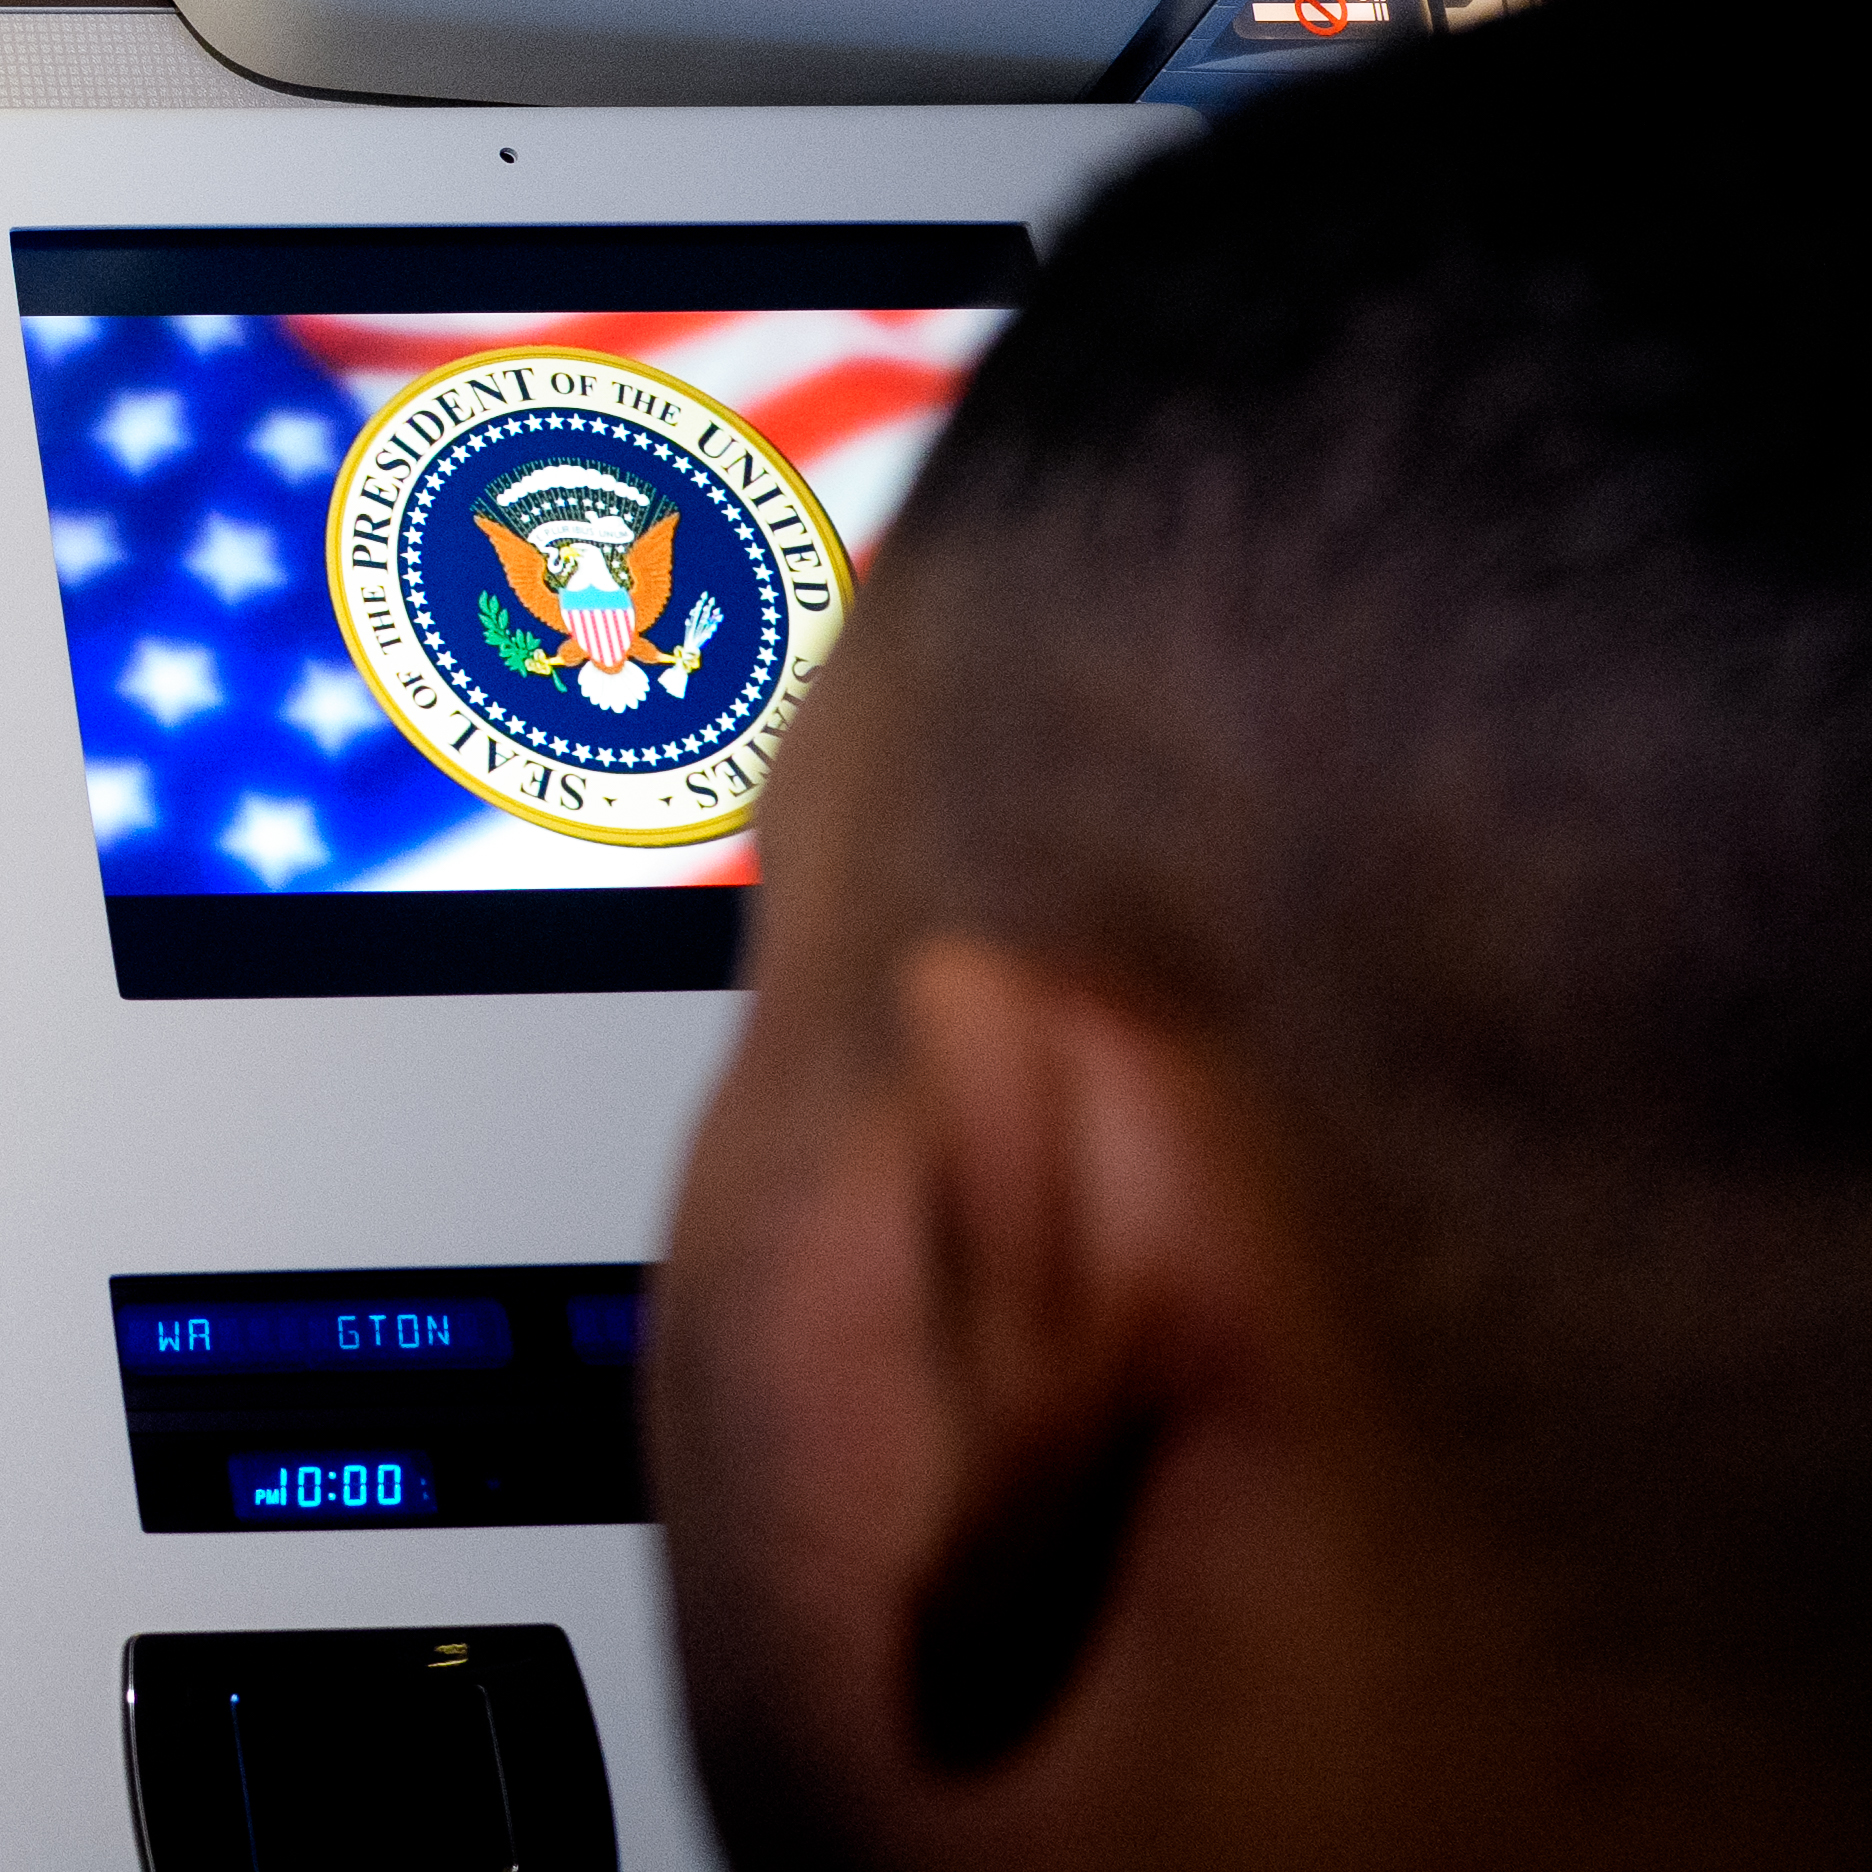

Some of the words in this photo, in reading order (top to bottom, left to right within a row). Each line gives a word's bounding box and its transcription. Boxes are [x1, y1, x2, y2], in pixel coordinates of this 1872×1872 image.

[549, 371, 597, 397] OF
[610, 380, 681, 427] THE
[352, 367, 537, 575] PRESIDENT
[696, 420, 831, 615] UNITED
[361, 584, 401, 655] THE
[395, 670, 439, 710] OF
[449, 712, 587, 810] SEAL
[157, 1318, 211, 1353] WA
[337, 1313, 452, 1350] GTON
[280, 1464, 402, 1508] 10:00
